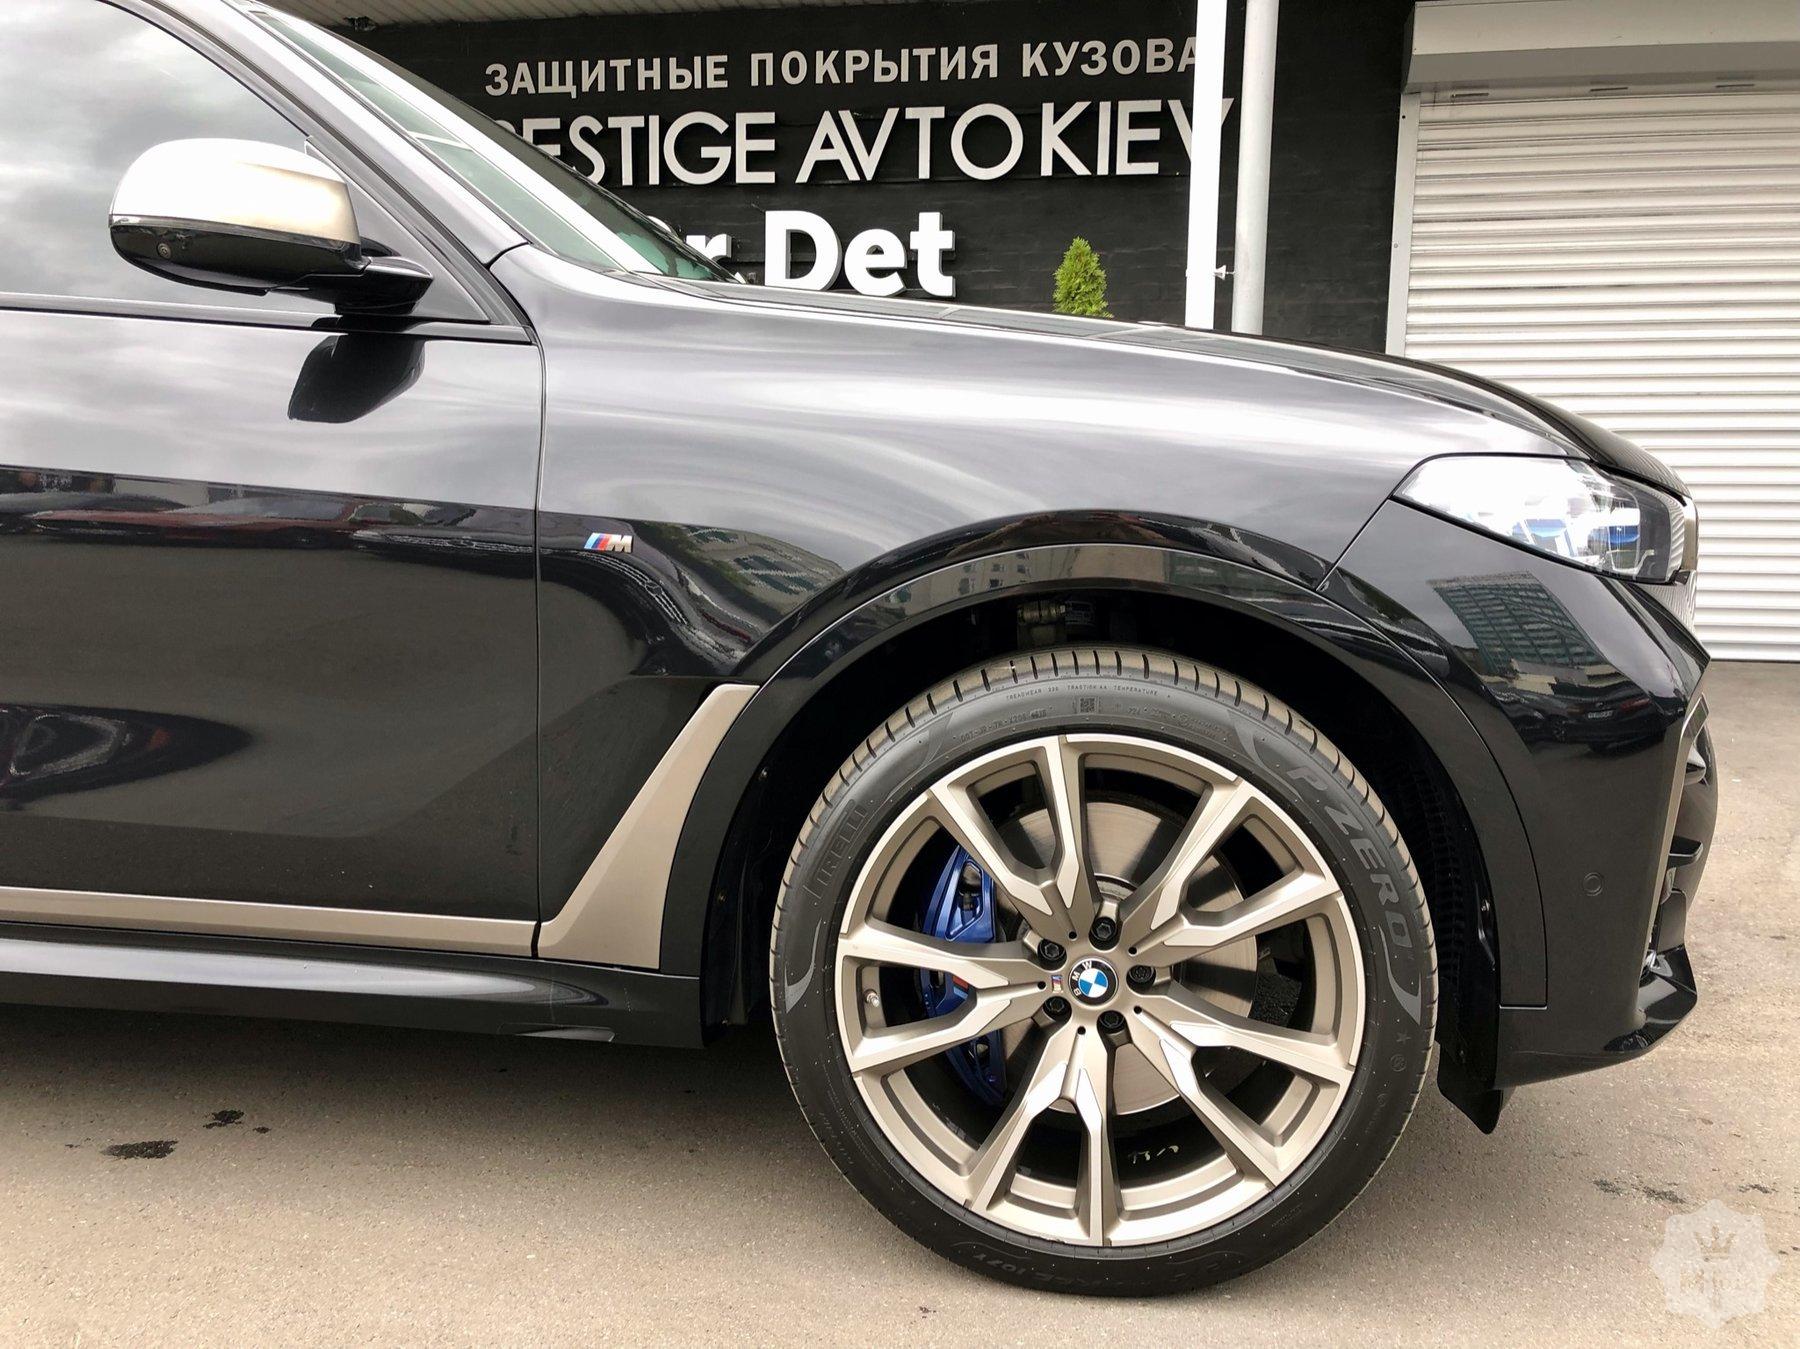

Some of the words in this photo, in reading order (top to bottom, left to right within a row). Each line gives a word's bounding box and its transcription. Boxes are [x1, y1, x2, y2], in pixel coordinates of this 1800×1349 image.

[485, 55, 728, 98] ЗАЩИТНЫЕ
[750, 43, 998, 87] ПОКРЫТИЯ
[1022, 36, 1196, 78] КУЗОВА
[496, 111, 777, 187] ESTIGE
[794, 103, 1025, 184] AVTO
[1040, 97, 1235, 177] KIEV
[764, 210, 956, 298] Det
[1286, 765, 1328, 792] P
[1324, 802, 1413, 949] ZERO
[1071, 960, 1093, 998] BMW
